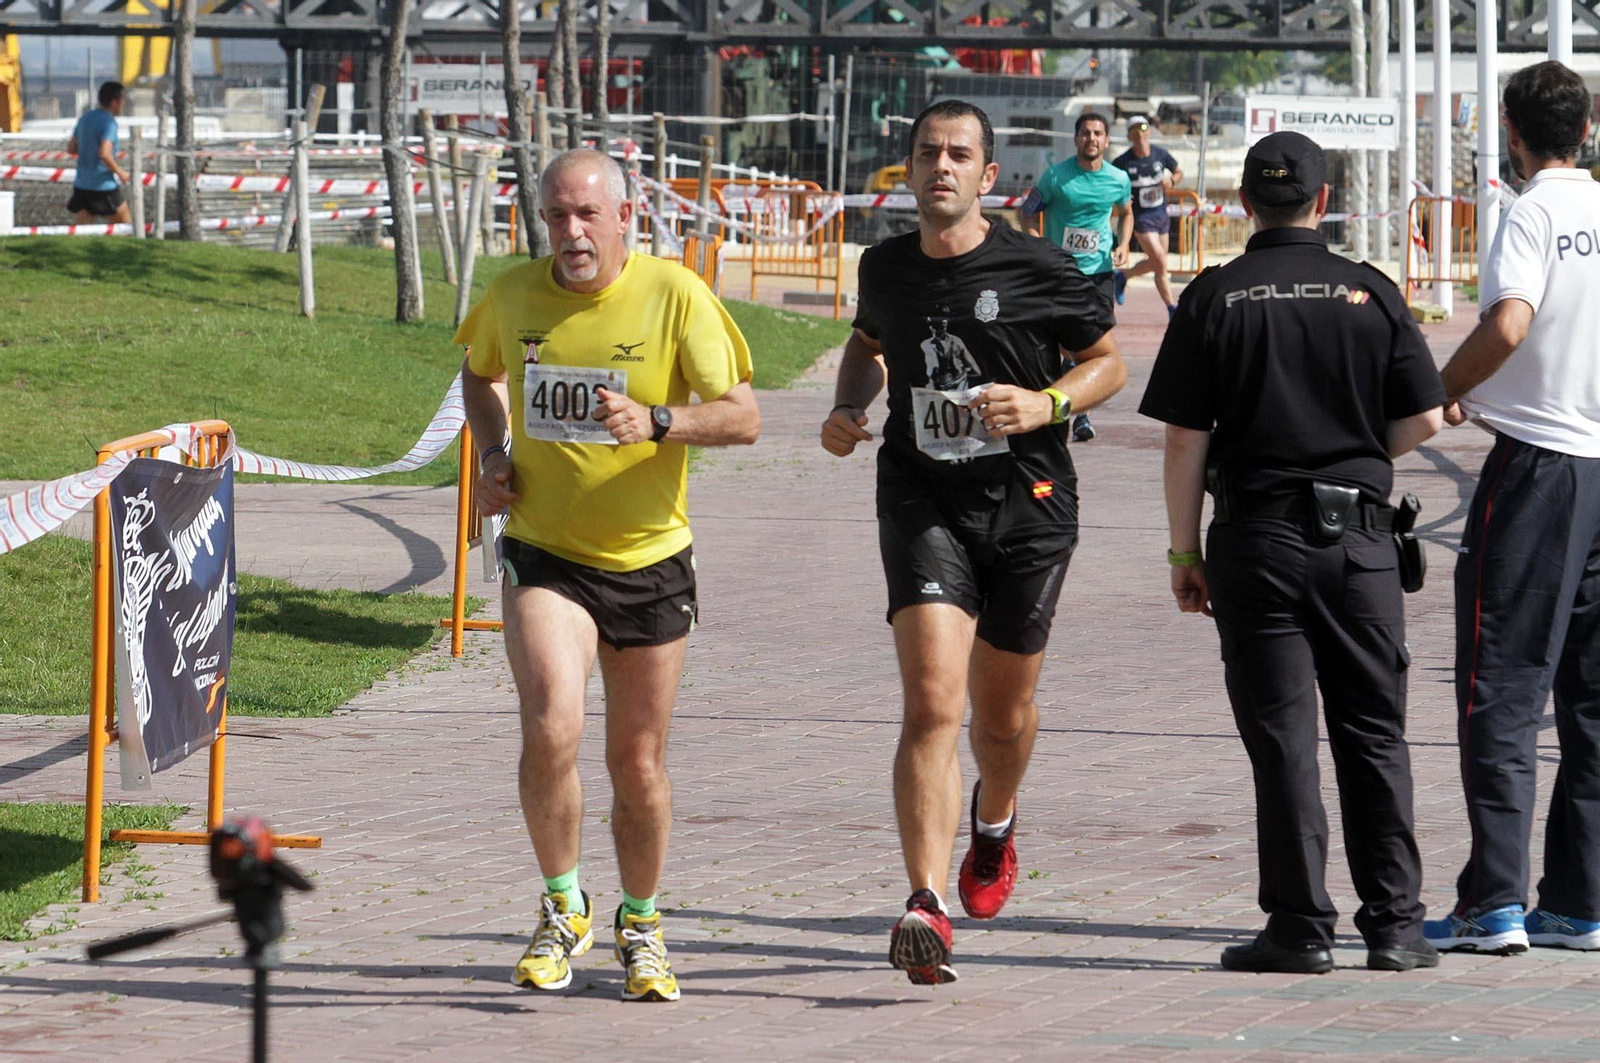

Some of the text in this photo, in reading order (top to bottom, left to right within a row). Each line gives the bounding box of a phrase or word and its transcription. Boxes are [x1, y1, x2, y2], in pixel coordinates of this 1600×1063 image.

[423, 80, 531, 91] SERANO
[1262, 169, 1288, 178] CNP
[1066, 233, 1098, 250] 4265
[1224, 283, 1350, 308] POLICIA
[923, 399, 979, 439] 407
